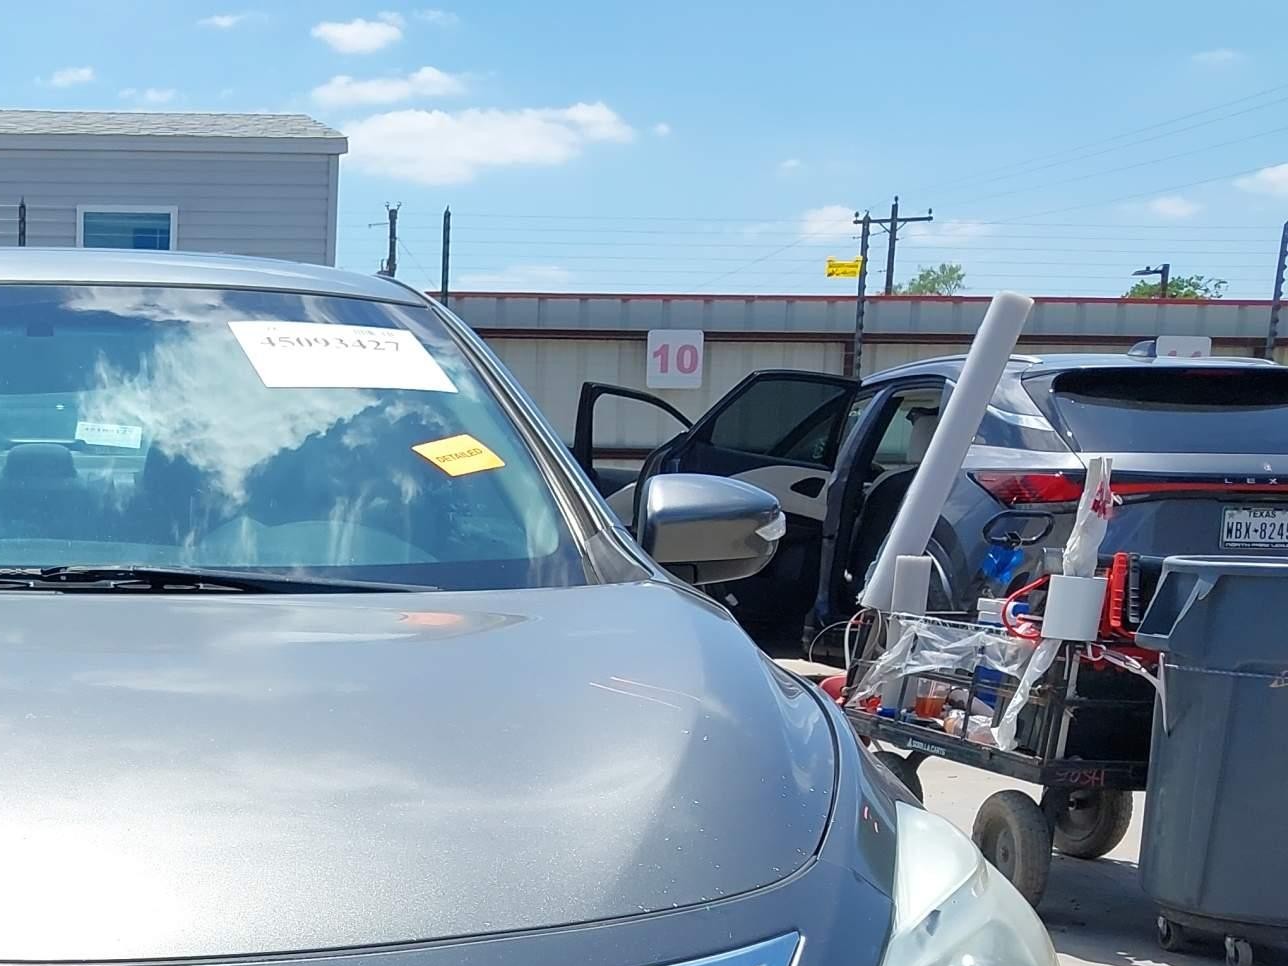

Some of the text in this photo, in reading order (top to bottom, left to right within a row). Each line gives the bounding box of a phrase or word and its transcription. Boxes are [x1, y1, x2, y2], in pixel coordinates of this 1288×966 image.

[259, 335, 400, 352] 45093427
[652, 343, 698, 375] 10
[435, 447, 484, 464] DETAILED
[1248, 510, 1277, 519] TEXAS
